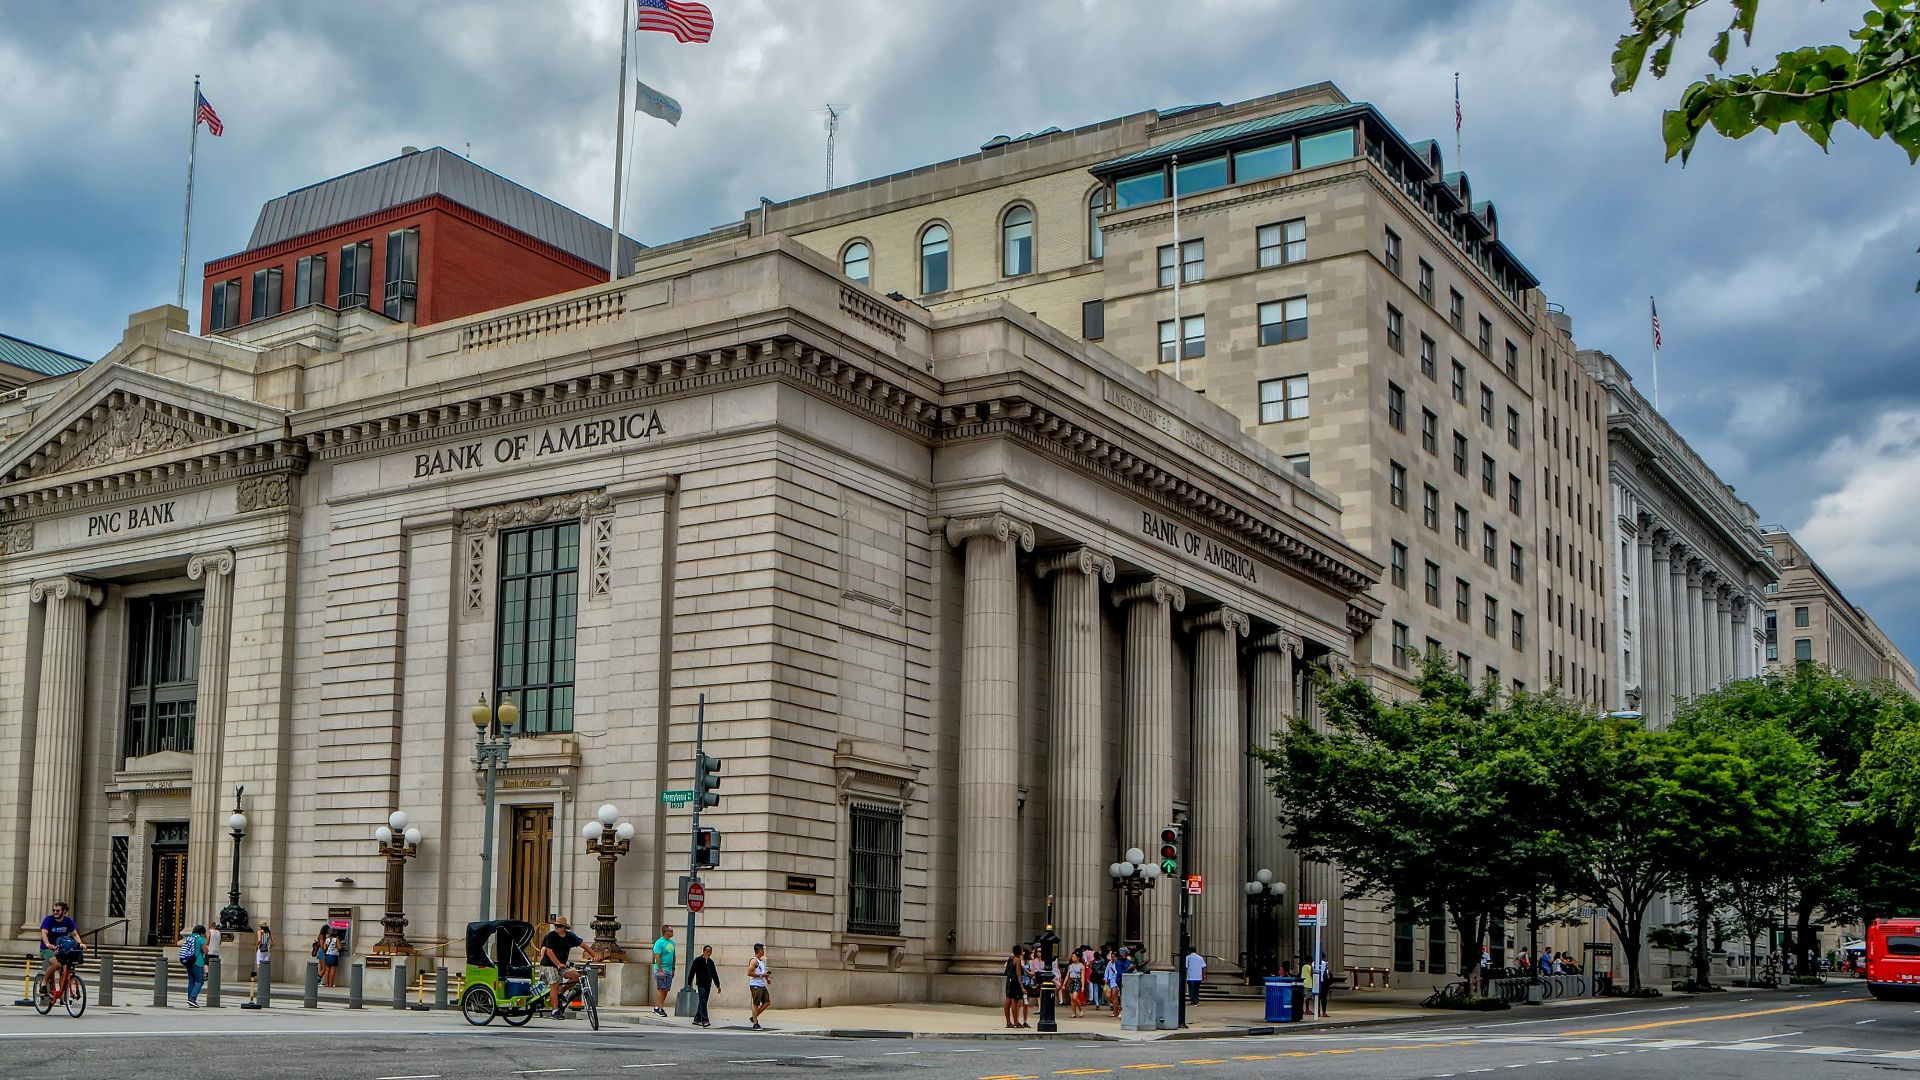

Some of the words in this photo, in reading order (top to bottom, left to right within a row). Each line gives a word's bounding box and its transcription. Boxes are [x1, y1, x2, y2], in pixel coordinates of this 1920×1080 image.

[414, 443, 483, 478] BANK
[494, 434, 528, 463] OF
[536, 409, 666, 456] AMERICA
[87, 511, 121, 537] PNC
[127, 501, 176, 530] BANK
[1142, 511, 1179, 548] BANK
[1183, 531, 1201, 557] OF
[1204, 540, 1257, 583] AMERICA
